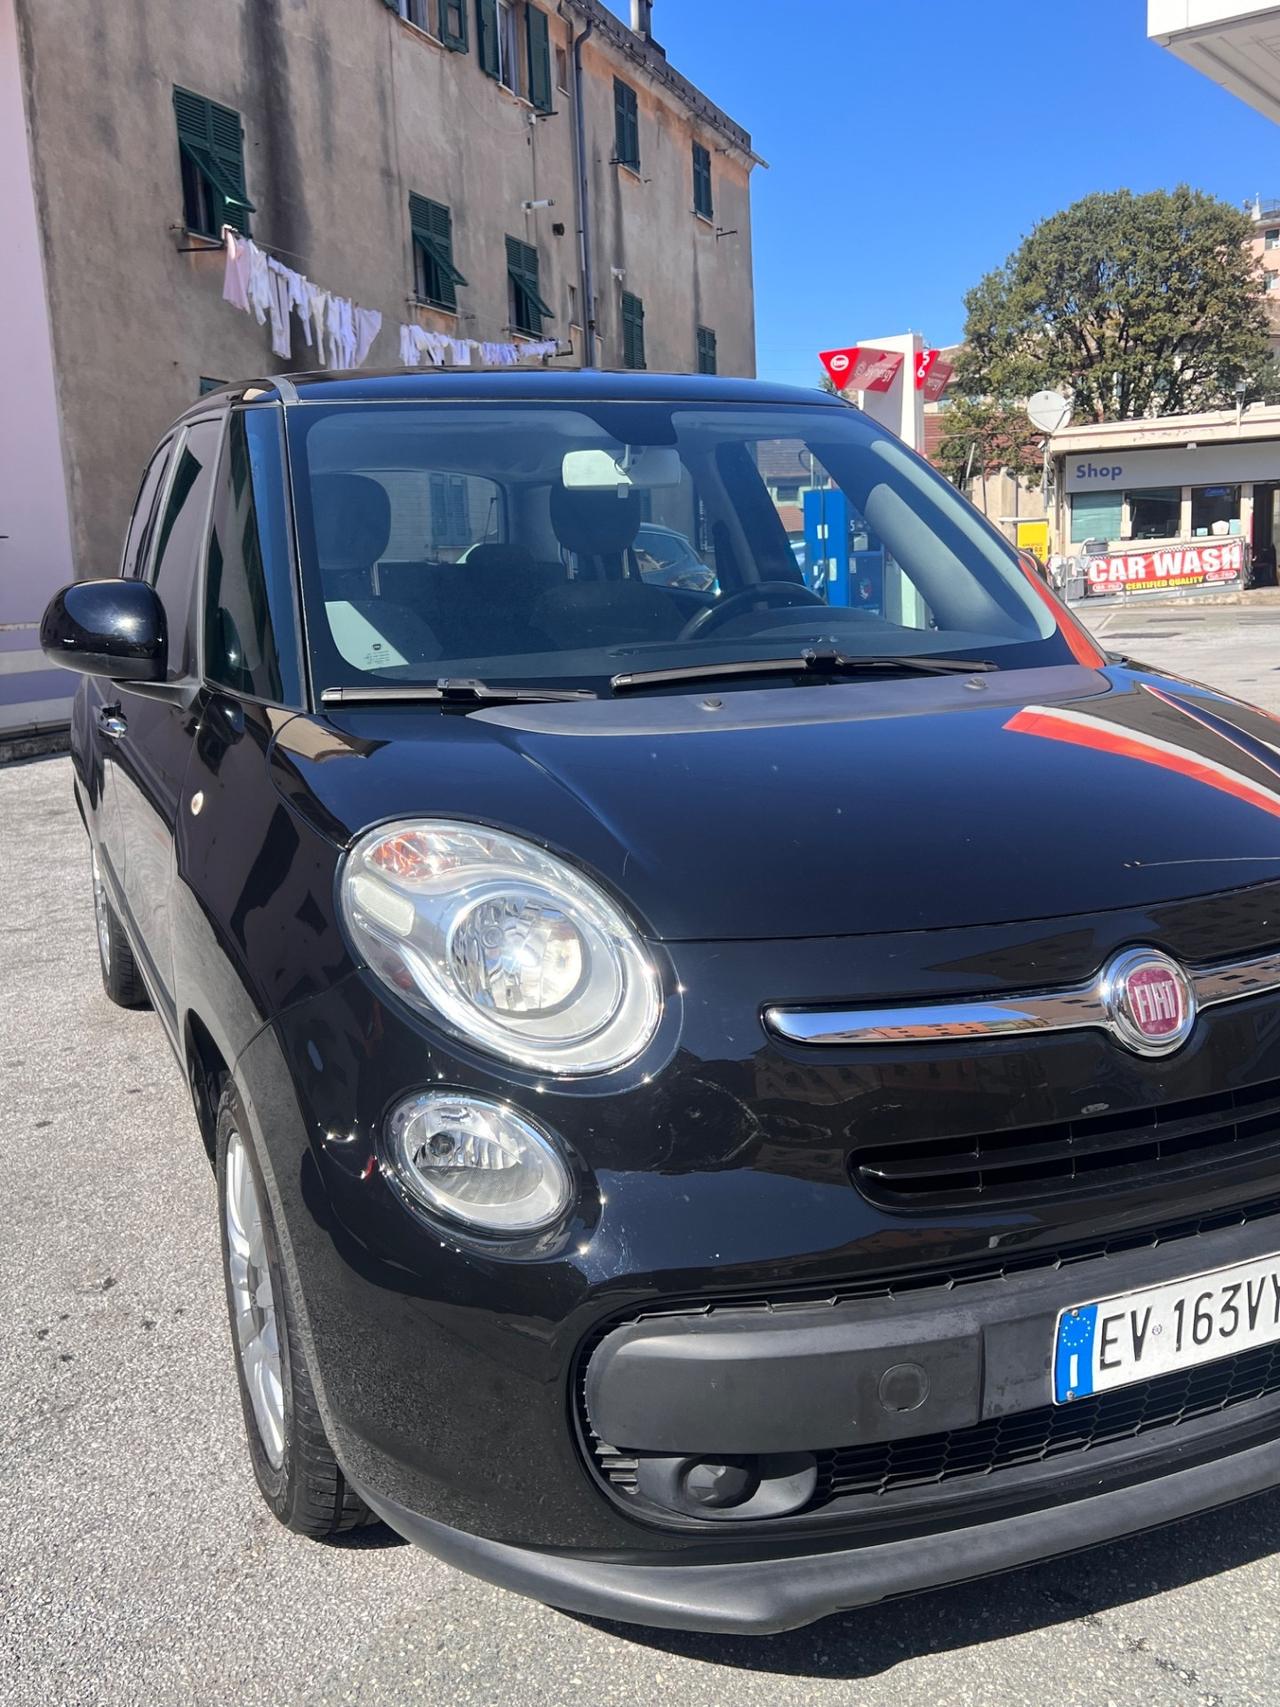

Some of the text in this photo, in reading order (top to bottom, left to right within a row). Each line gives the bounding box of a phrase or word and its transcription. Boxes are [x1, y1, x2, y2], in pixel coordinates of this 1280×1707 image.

[1076, 463, 1123, 481] Shop
[1089, 545, 1242, 583] CAR WASH
[1125, 579, 1168, 591] CERTIFIED
[1169, 575, 1204, 587] QUALITY
[1134, 980, 1177, 1024] FIAT
[1100, 1306, 1153, 1371] EV
[1070, 1354, 1079, 1388] I
